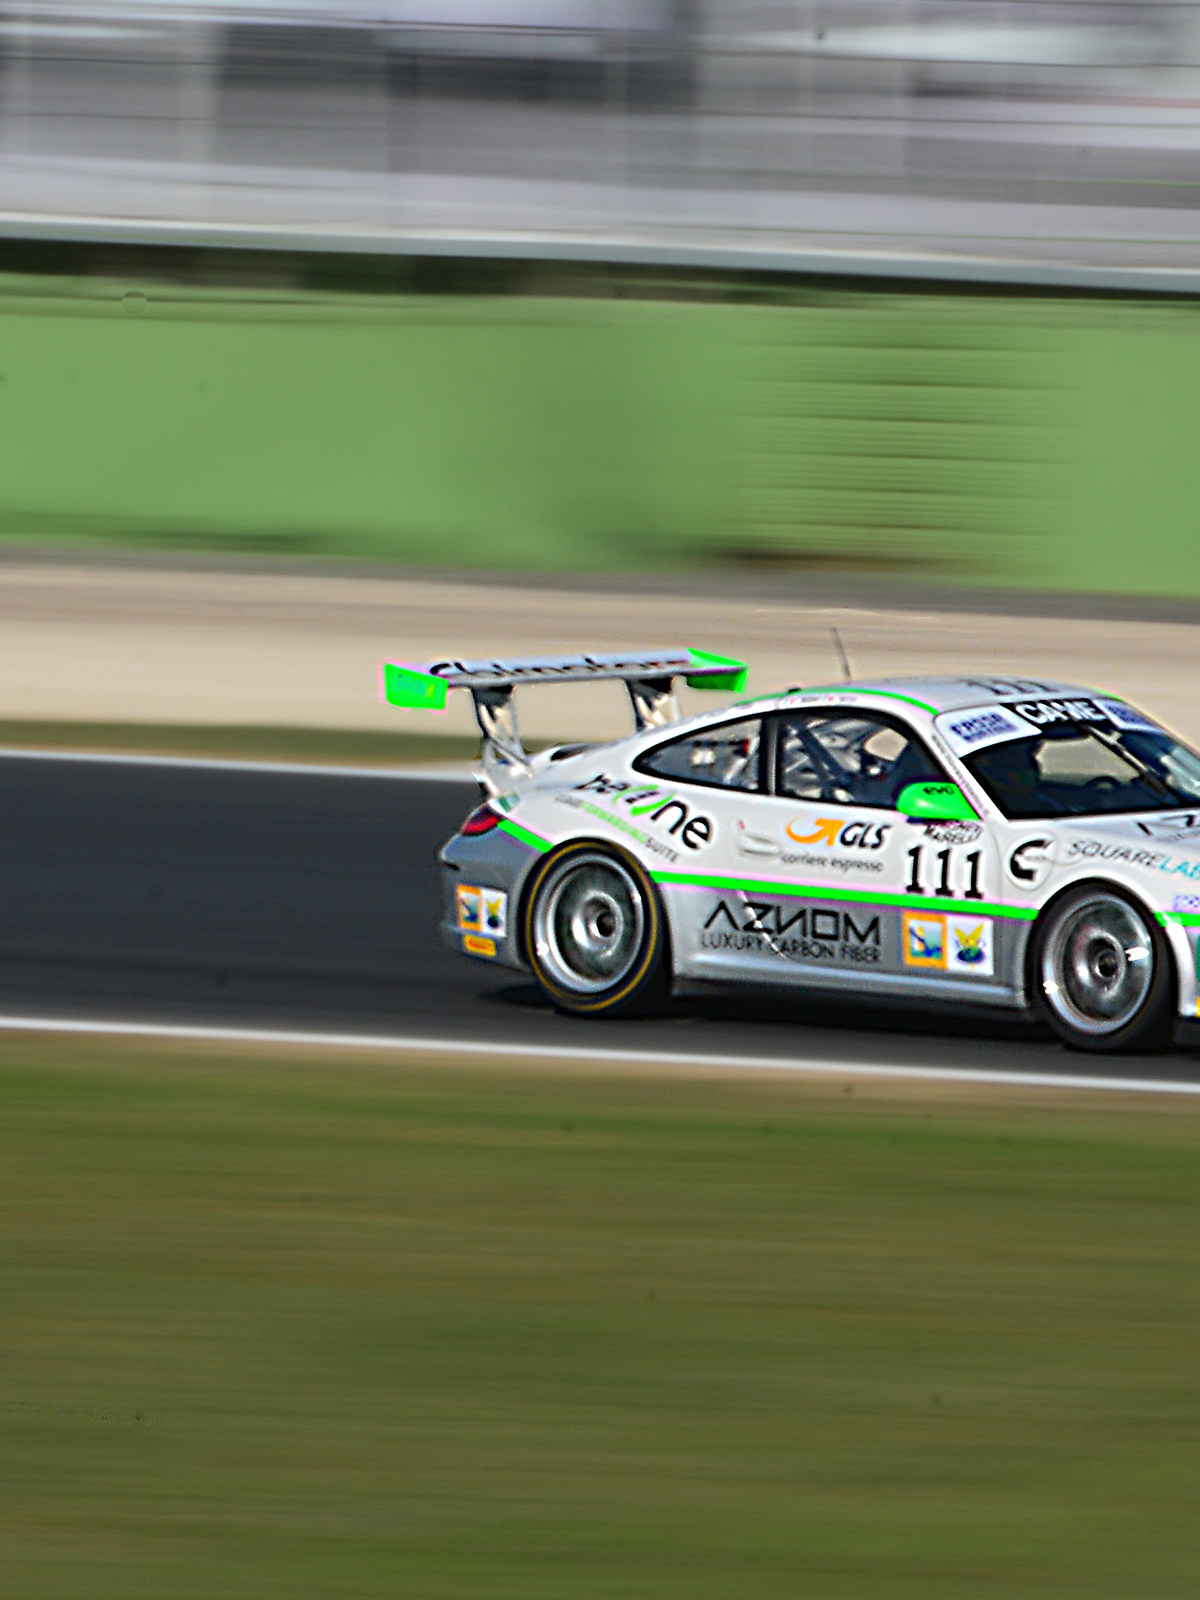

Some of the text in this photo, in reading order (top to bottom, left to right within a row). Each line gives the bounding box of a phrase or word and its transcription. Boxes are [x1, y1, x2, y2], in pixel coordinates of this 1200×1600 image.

[839, 821, 890, 850] GLS
[781, 853, 883, 873] corriere espresso
[905, 844, 984, 900] 111
[703, 900, 881, 947] AZNOM
[701, 931, 763, 951] LUXURY
